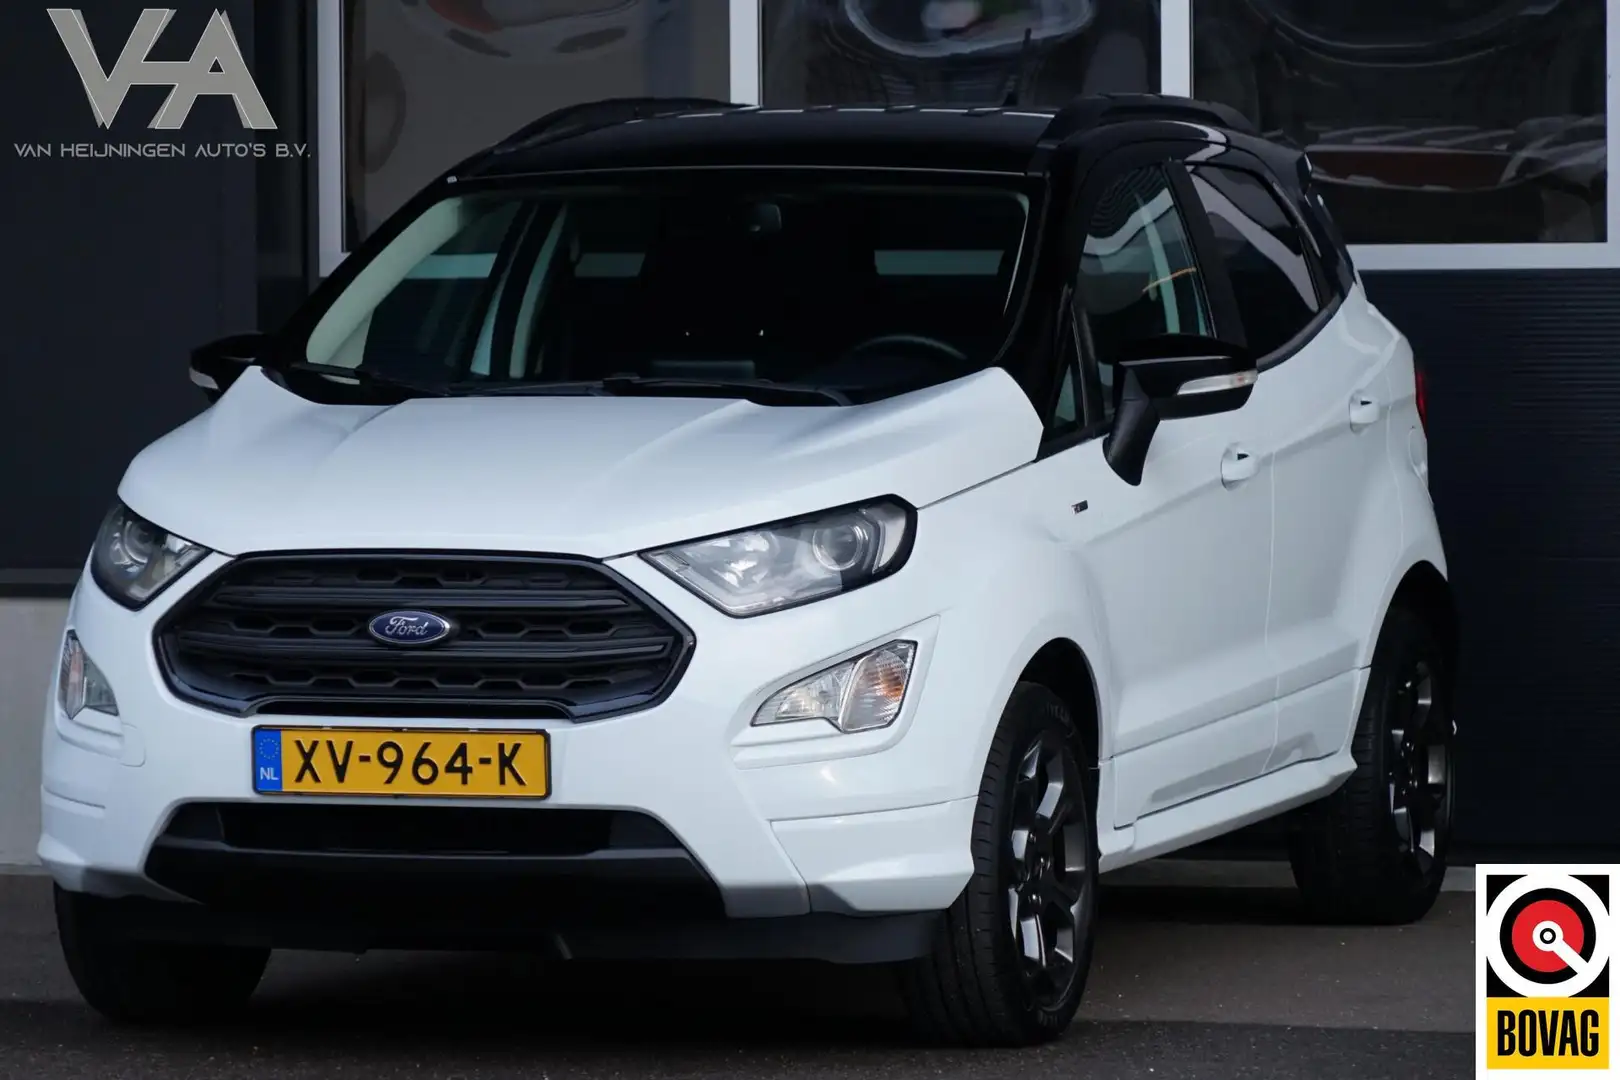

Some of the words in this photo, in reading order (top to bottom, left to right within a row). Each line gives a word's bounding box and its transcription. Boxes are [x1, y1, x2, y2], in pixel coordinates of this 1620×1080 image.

[384, 616, 428, 636] Ford
[294, 739, 527, 787] XV-964-K
[260, 767, 279, 781] NL
